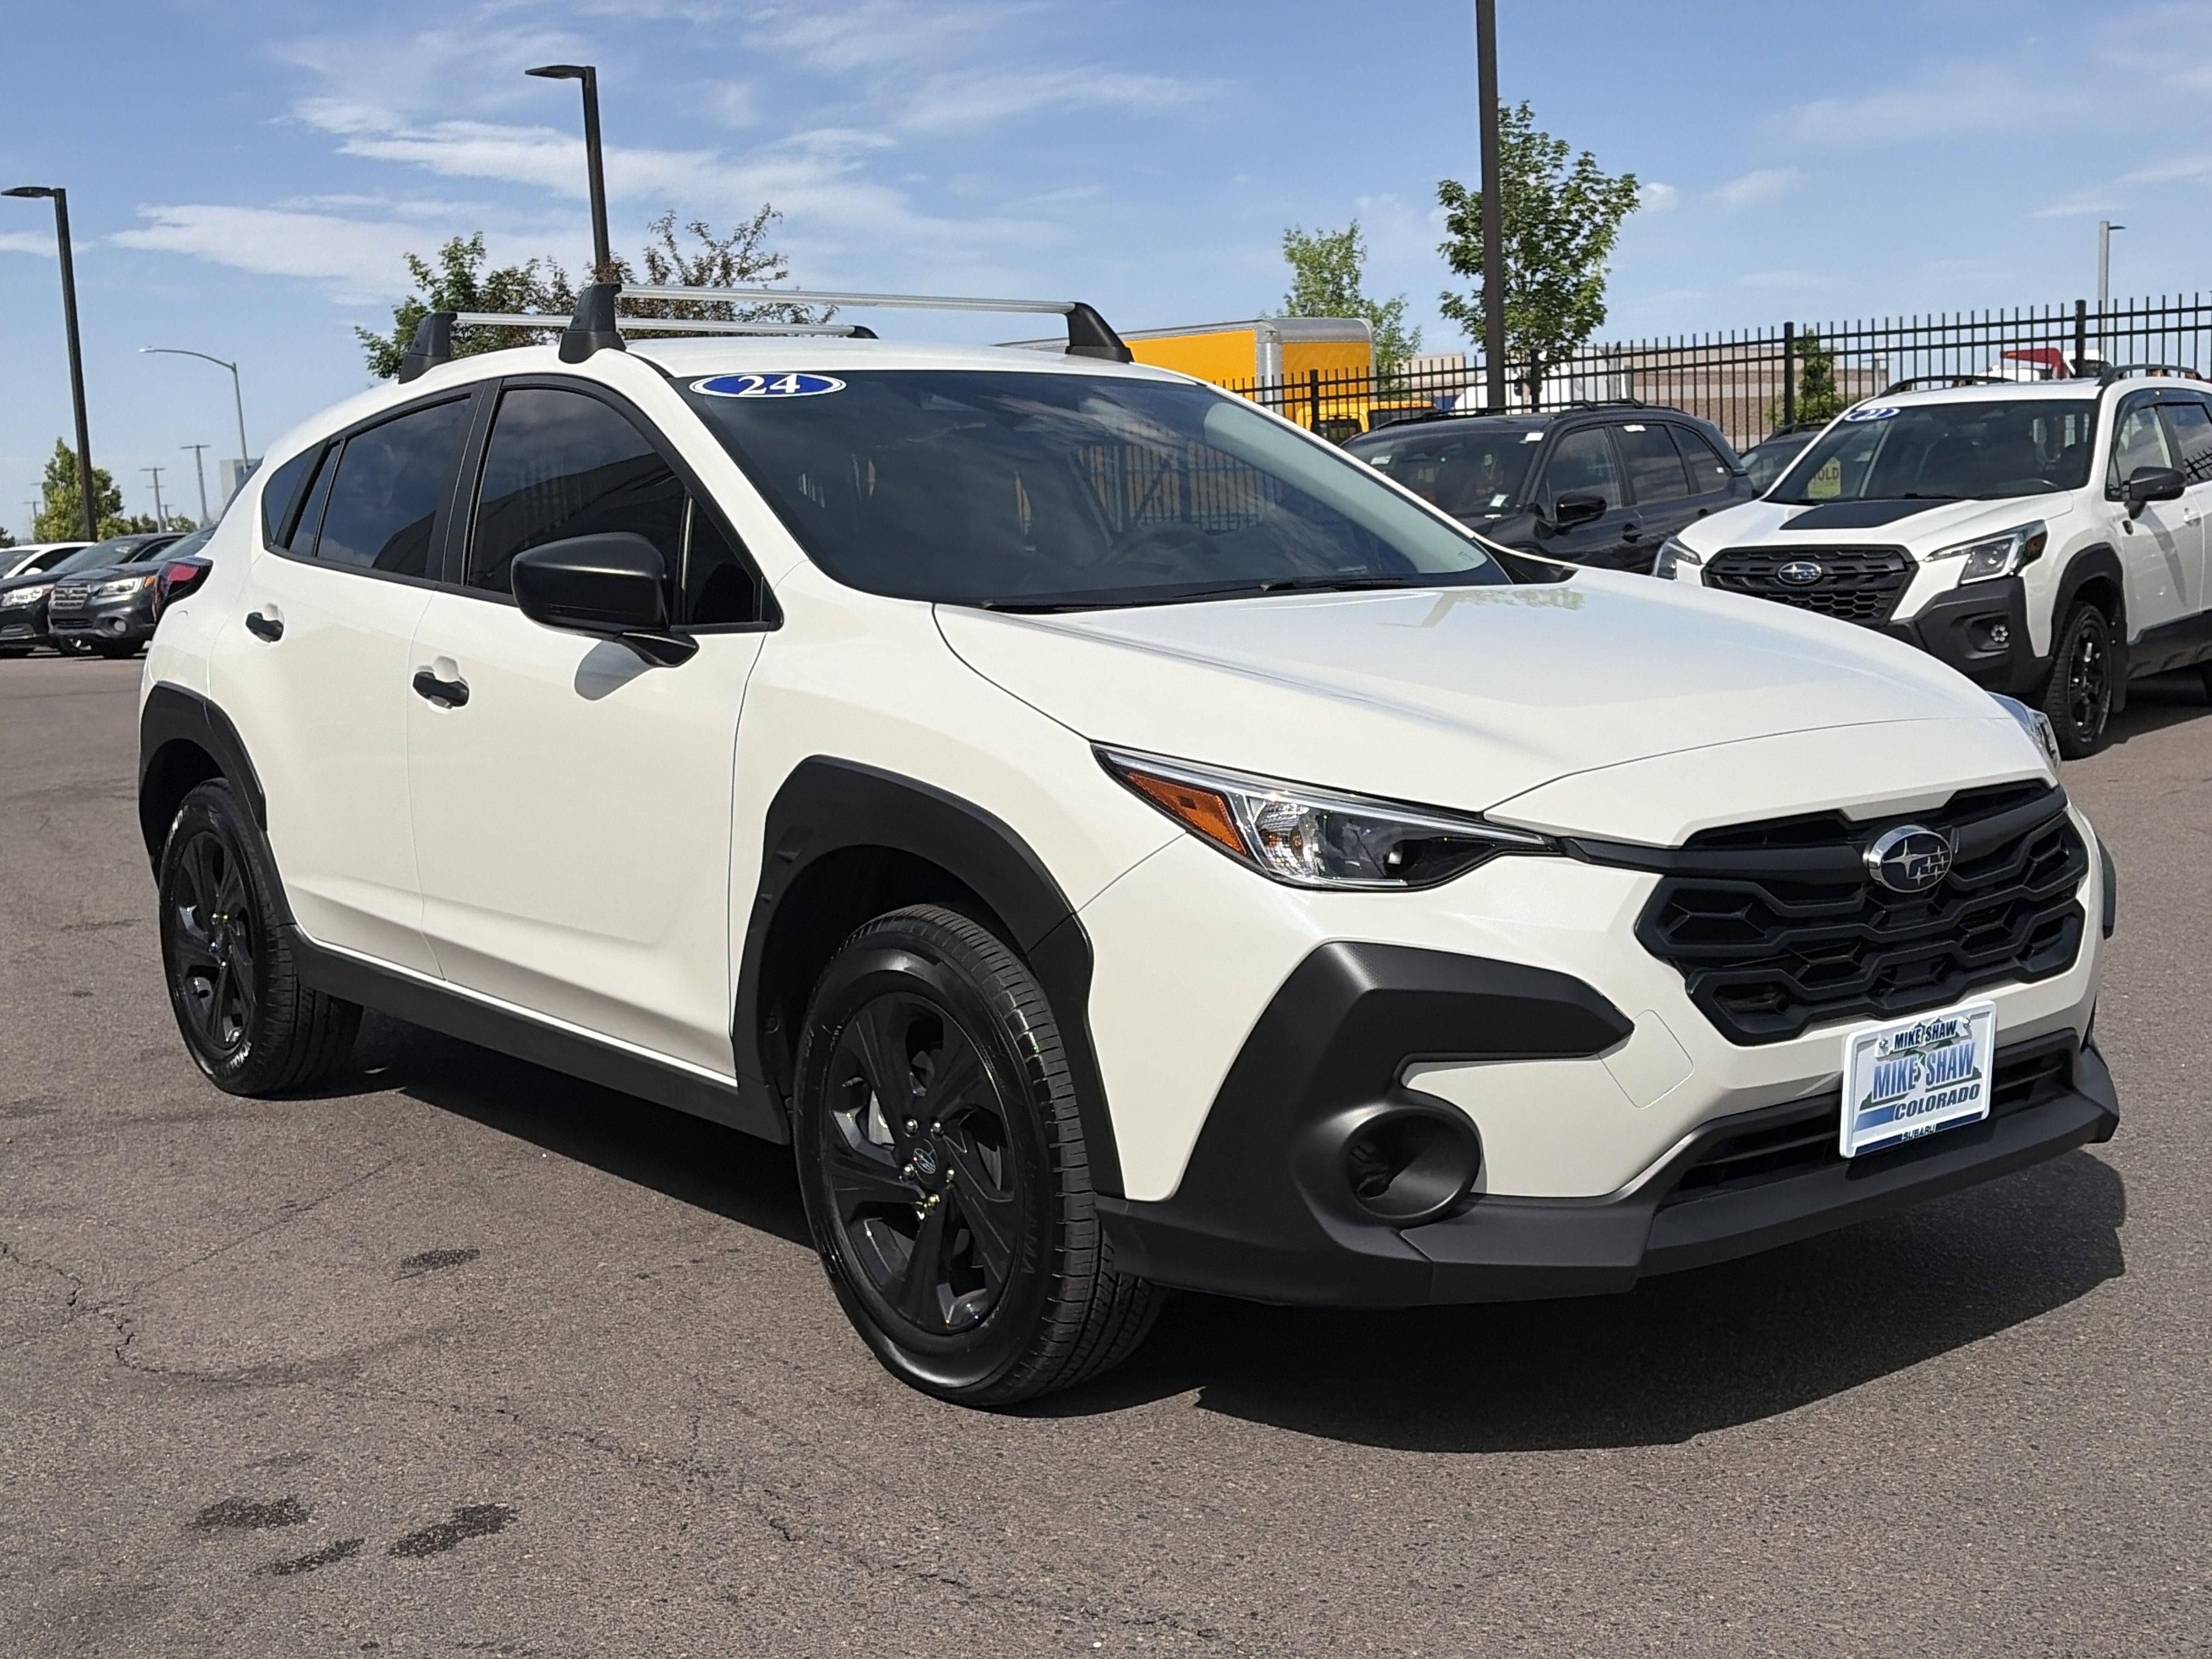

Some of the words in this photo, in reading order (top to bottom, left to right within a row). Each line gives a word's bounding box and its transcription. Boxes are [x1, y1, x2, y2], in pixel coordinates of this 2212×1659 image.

[737, 374, 800, 396] 24
[1814, 466, 1839, 482] OLD
[1894, 1029, 1921, 1049] MIKE
[1925, 1019, 1957, 1041] SHAW
[1873, 1057, 1918, 1100] MIKE
[1925, 1043, 1975, 1086] SHAW
[1894, 1084, 1980, 1121] COLORADO
[1903, 1124, 1936, 1141] SUBARU
